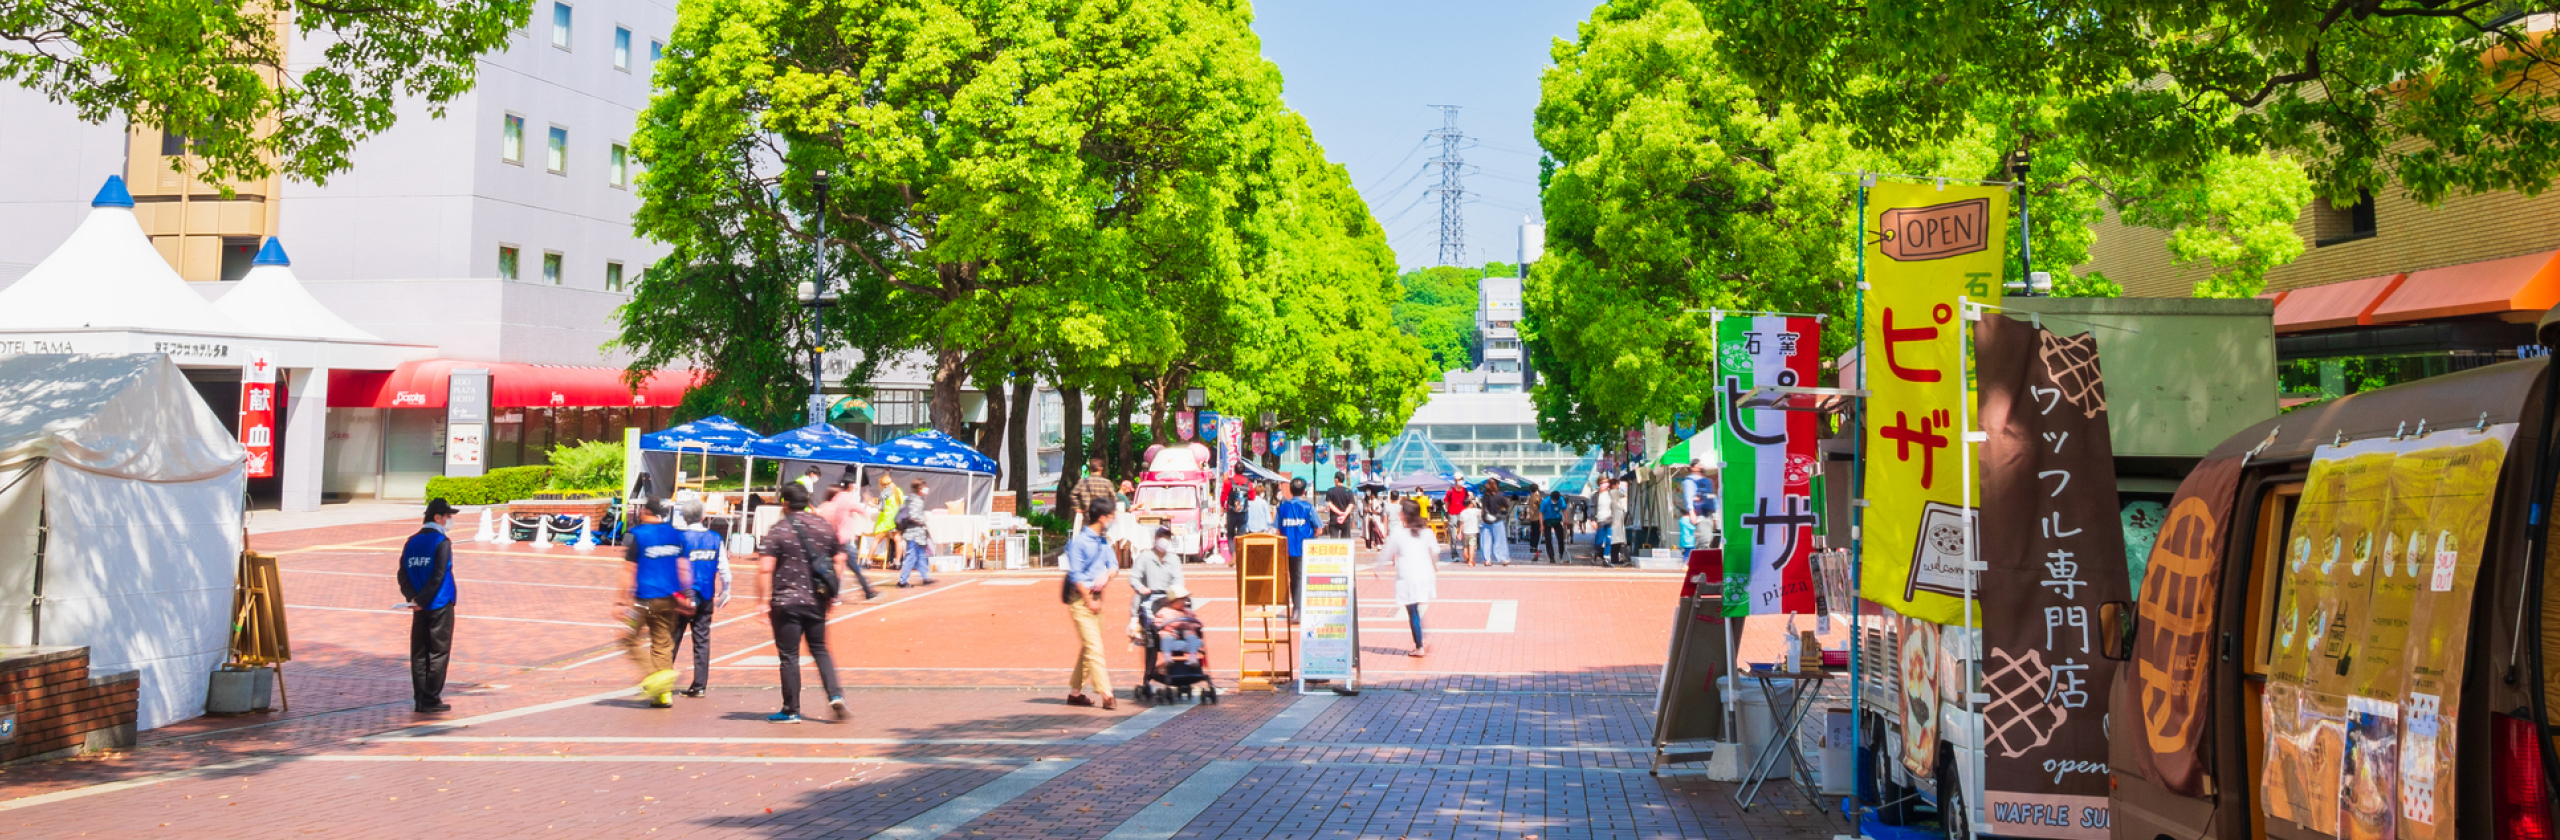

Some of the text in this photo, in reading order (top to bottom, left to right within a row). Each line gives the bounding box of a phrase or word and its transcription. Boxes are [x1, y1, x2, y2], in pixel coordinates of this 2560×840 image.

[1907, 213, 1971, 248] OPEN
[33, 341, 74, 355] TAMA
[1743, 332, 1800, 355] 石窯
[1881, 302, 1953, 490] ピザ
[246, 387, 271, 447] 献血
[1725, 370, 1819, 570] ピザ
[689, 549, 717, 561] STAFF
[2030, 385, 2089, 708] ワッフル専門店
[1762, 580, 1808, 607] pizza
[2042, 758, 2110, 785] open
[1994, 802, 2111, 829] WAFFLE SU
